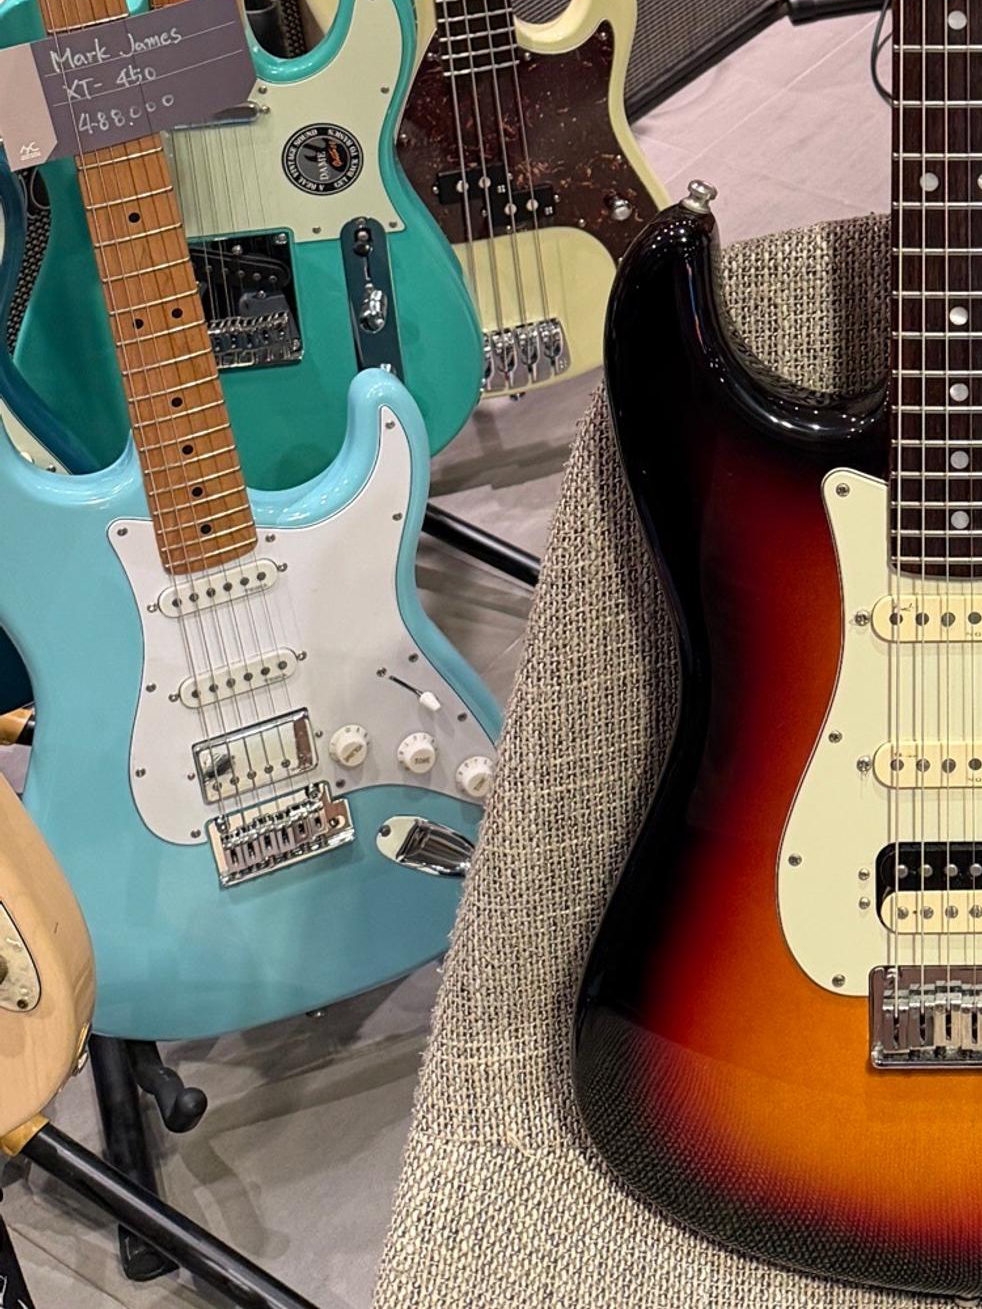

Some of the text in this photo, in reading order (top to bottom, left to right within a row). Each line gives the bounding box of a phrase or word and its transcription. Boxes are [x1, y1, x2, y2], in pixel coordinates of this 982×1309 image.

[50, 27, 183, 73] Mark James
[78, 94, 175, 135] 488.000
